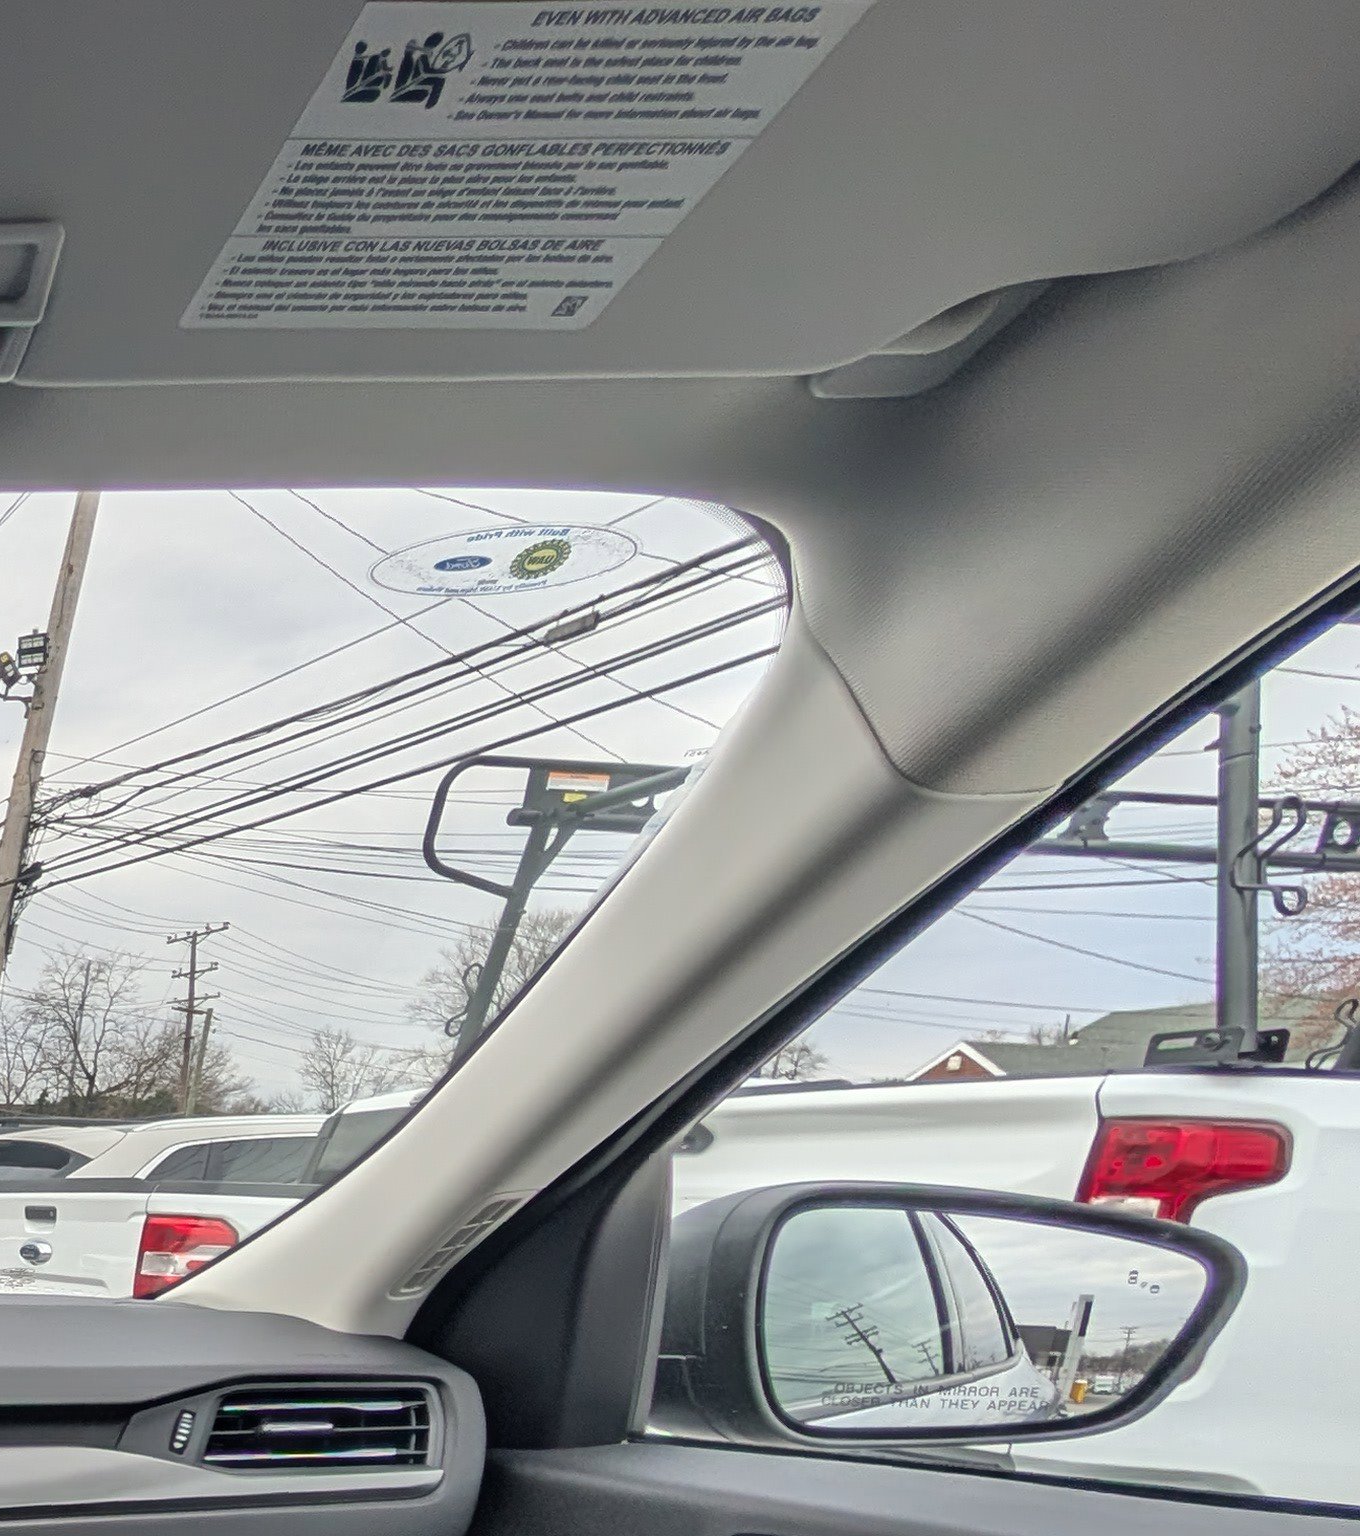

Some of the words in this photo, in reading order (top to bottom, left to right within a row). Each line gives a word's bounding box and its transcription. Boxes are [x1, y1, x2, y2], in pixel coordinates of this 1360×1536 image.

[532, 10, 583, 24] EVEN
[582, 9, 632, 23] WITH
[631, 9, 731, 23] ADVANCED
[728, 9, 765, 23] AIR
[763, 8, 820, 22] BAGS
[351, 144, 395, 155] AVEC
[398, 144, 432, 155] DES
[434, 144, 479, 155] SACS
[482, 143, 592, 155] GONFLABLES
[262, 241, 342, 251] INCLUSIVE
[343, 241, 378, 250] CON
[380, 241, 410, 250] LAS
[413, 241, 474, 250] NUEVAS
[476, 241, 539, 250] BOLSAS
[540, 241, 564, 250] DE
[564, 241, 603, 250] AIRE
[833, 1383, 903, 1395] OBJECTS
[913, 1385, 929, 1396] IN
[938, 1385, 1000, 1397] MIRROR
[1008, 1387, 1040, 1398] ARE
[821, 1395, 881, 1406] CLOSER
[891, 1397, 930, 1409] THAN
[939, 1399, 978, 1410] THEY
[986, 1400, 1049, 1412] APPEAR
